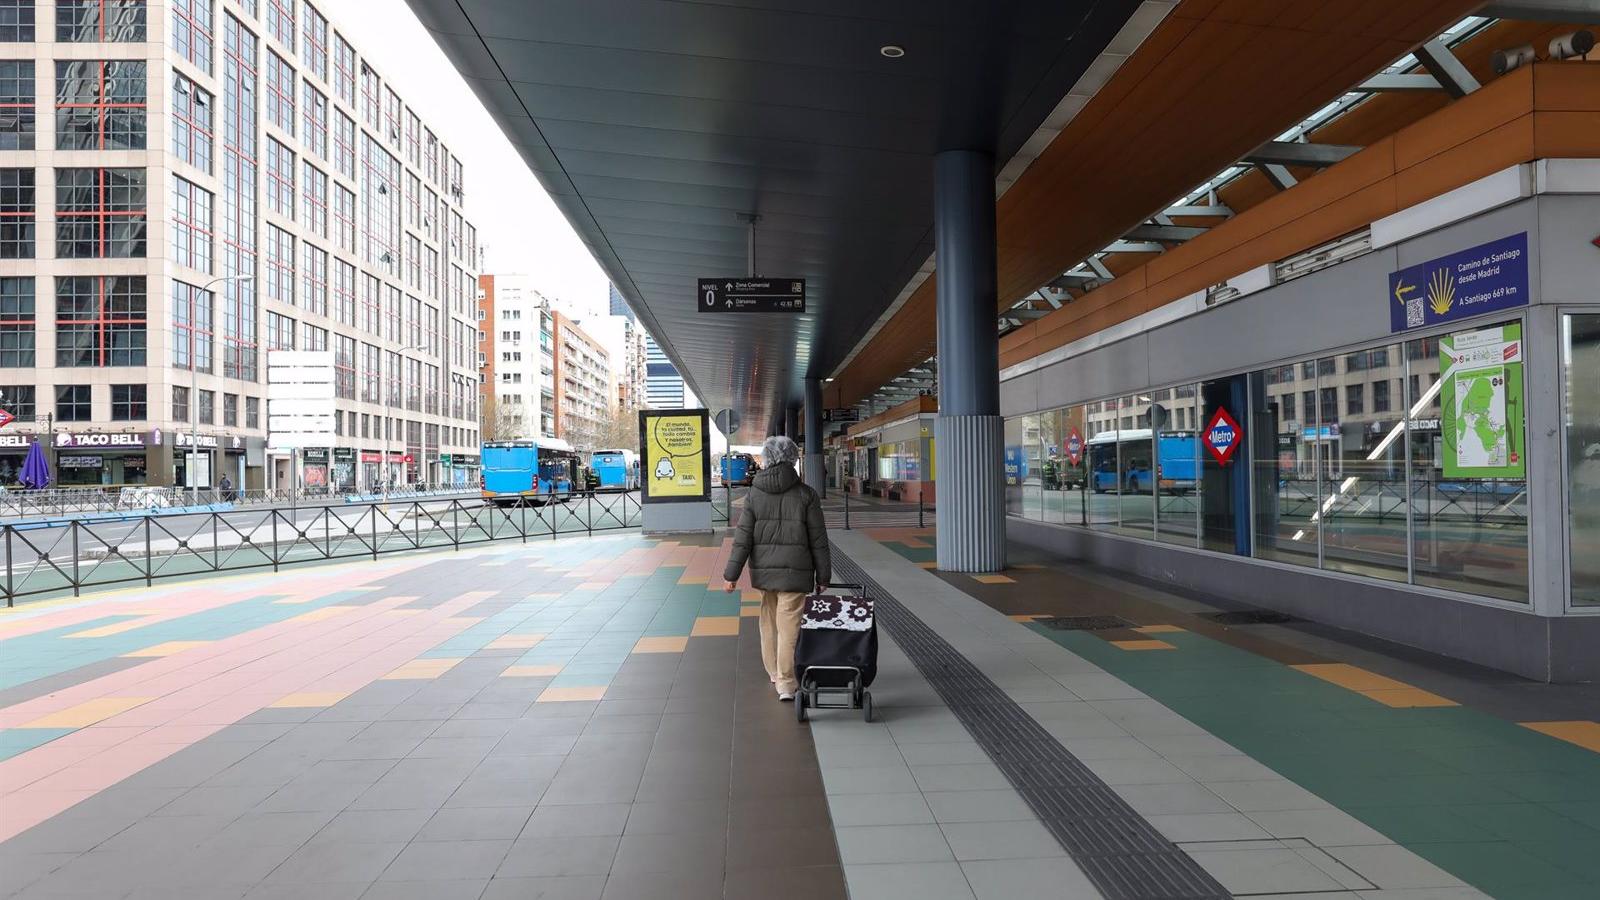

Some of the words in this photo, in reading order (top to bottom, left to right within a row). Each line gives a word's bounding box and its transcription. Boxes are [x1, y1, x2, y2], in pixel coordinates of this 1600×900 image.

[1457, 260, 1481, 272] Camino
[1482, 256, 1490, 266] de
[1491, 249, 1521, 263] Santiago
[1458, 272, 1477, 284] desde
[1477, 265, 1500, 280] Madrid
[706, 290, 715, 306] 0
[1459, 297, 1465, 306] A
[1464, 292, 1491, 305] Santiago
[1492, 287, 1505, 298] 669
[1505, 286, 1517, 295] km
[0, 435, 31, 447] BELL
[74, 434, 109, 446] TACO
[110, 434, 143, 446] BELL
[1211, 430, 1232, 443] Metro
